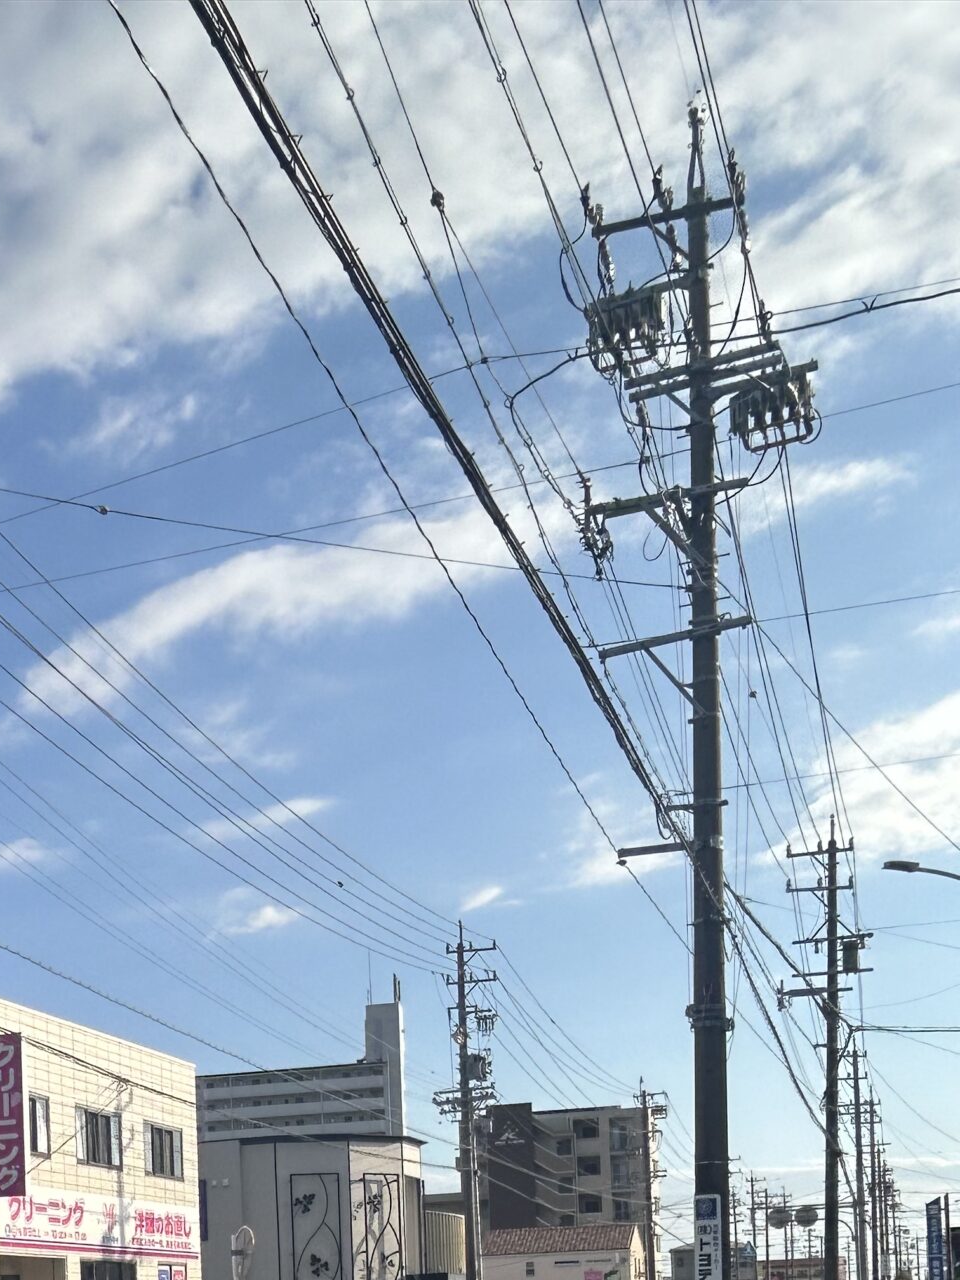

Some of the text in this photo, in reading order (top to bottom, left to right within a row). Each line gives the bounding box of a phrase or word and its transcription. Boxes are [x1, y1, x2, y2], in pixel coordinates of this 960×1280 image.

[7, 1195, 85, 1227] クリーニング
